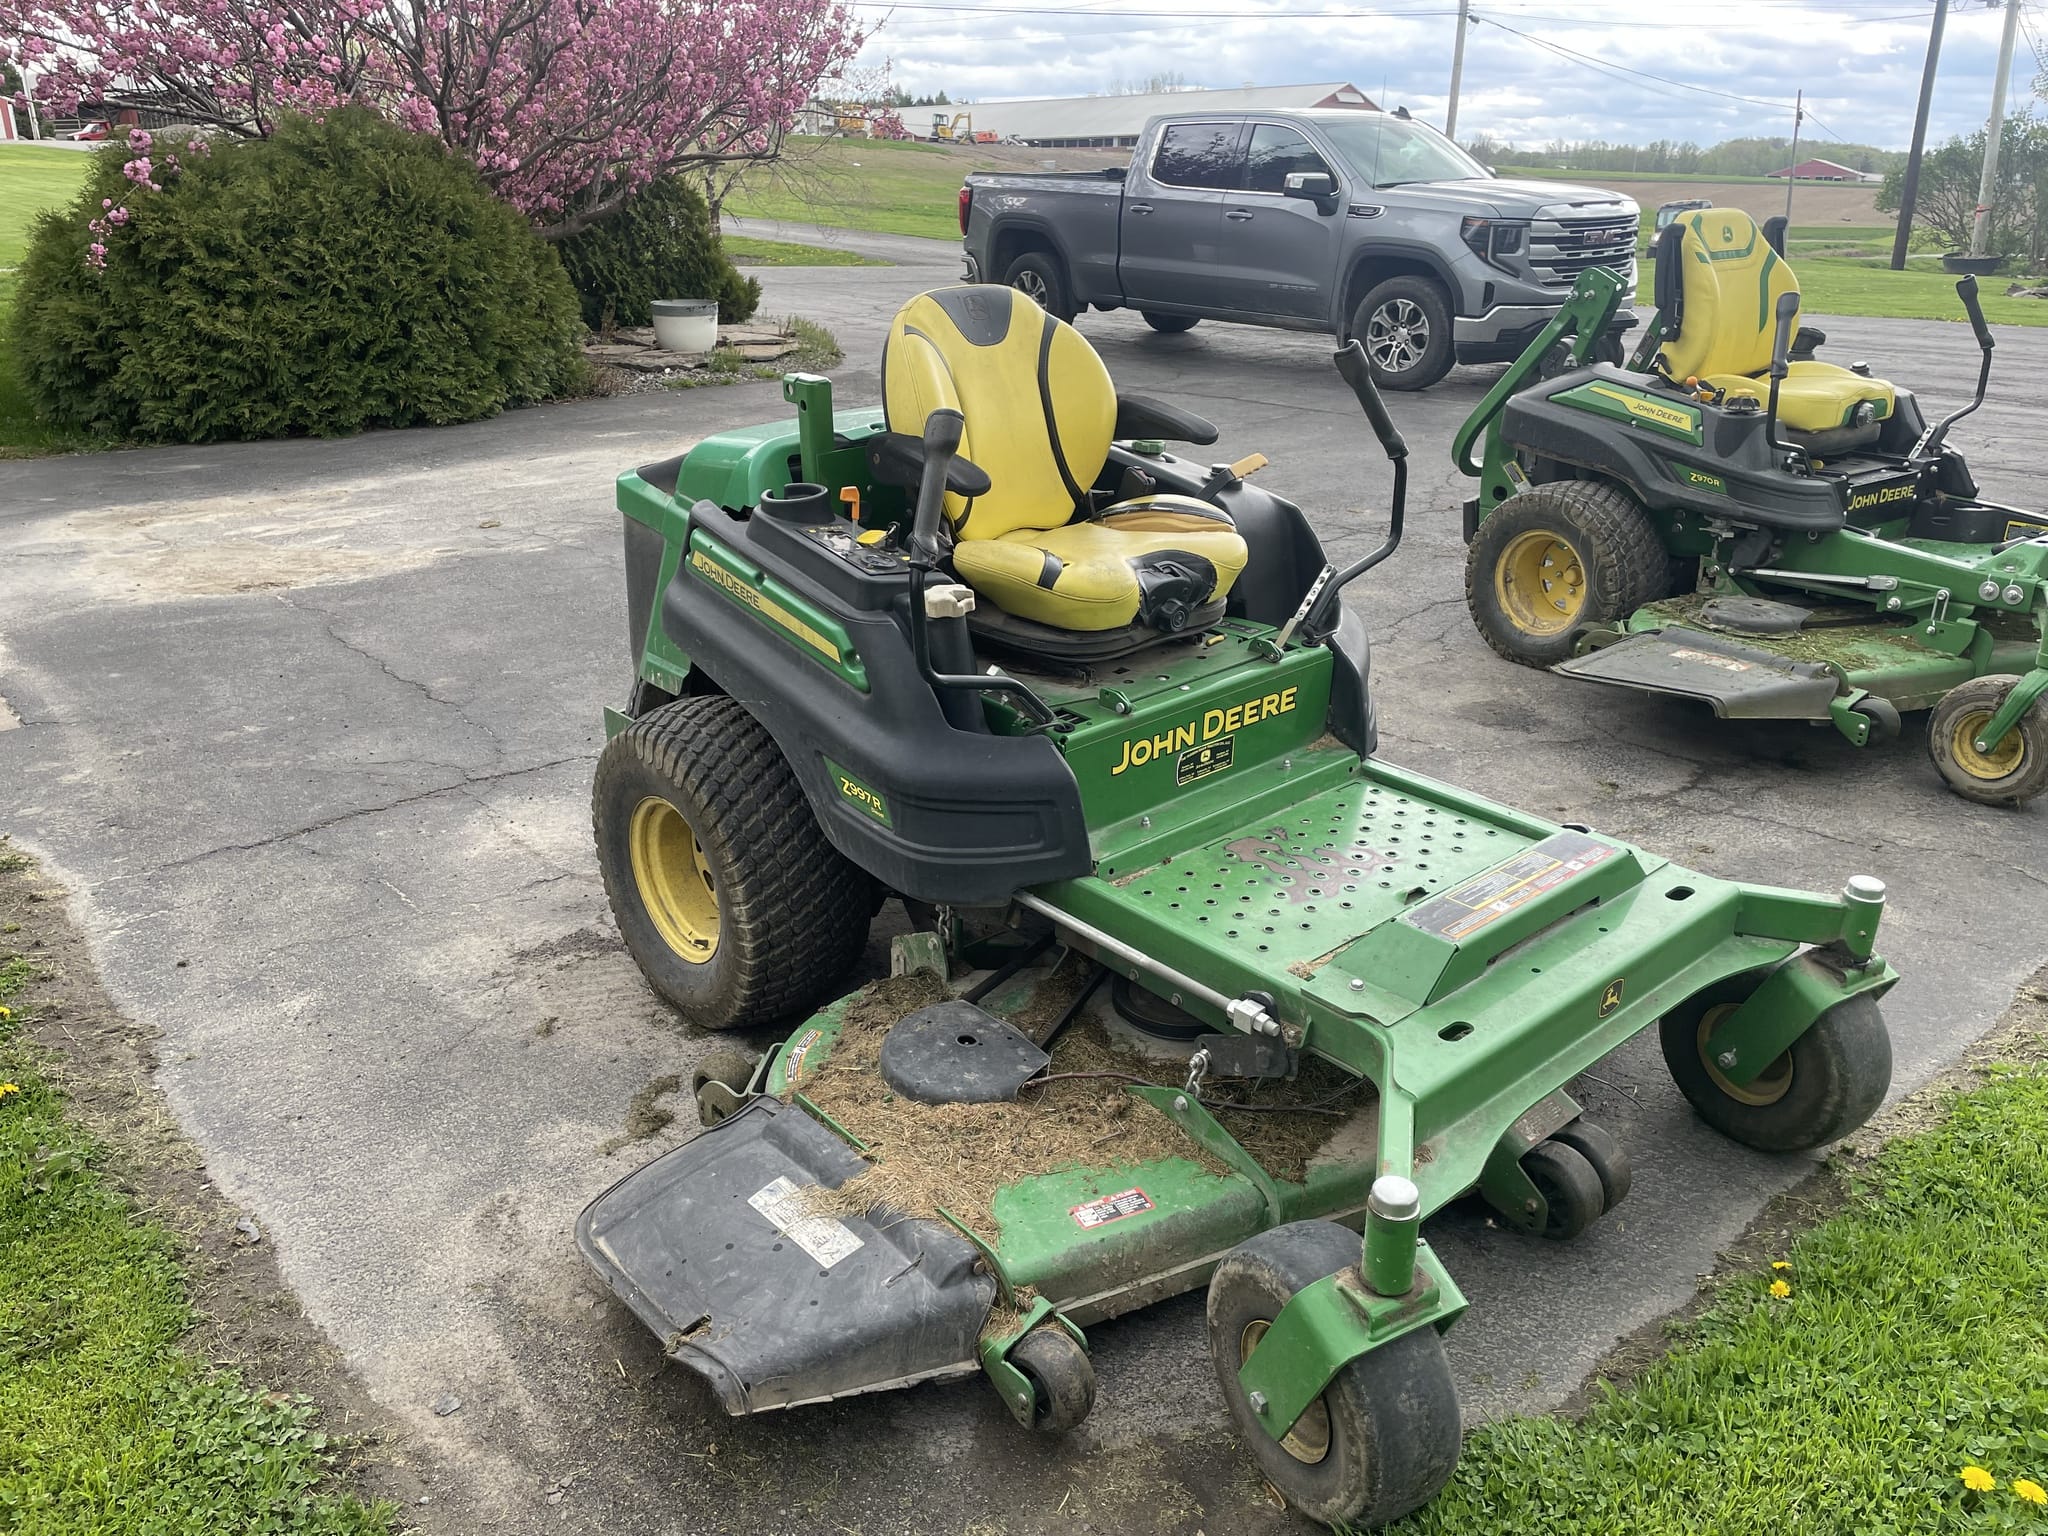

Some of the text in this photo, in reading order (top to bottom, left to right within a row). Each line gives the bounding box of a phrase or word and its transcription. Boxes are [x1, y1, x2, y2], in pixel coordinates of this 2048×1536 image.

[1583, 229, 1622, 245] GMC
[1633, 402, 1685, 424] JOHN DEERE
[1689, 472, 1721, 487] Z970R
[1847, 484, 1916, 511] JOHN DEERE
[698, 556, 761, 610] JOHN DEERE
[1111, 721, 1196, 776] JOHN
[1202, 685, 1298, 741] DEERE
[839, 775, 882, 811] Z997R
